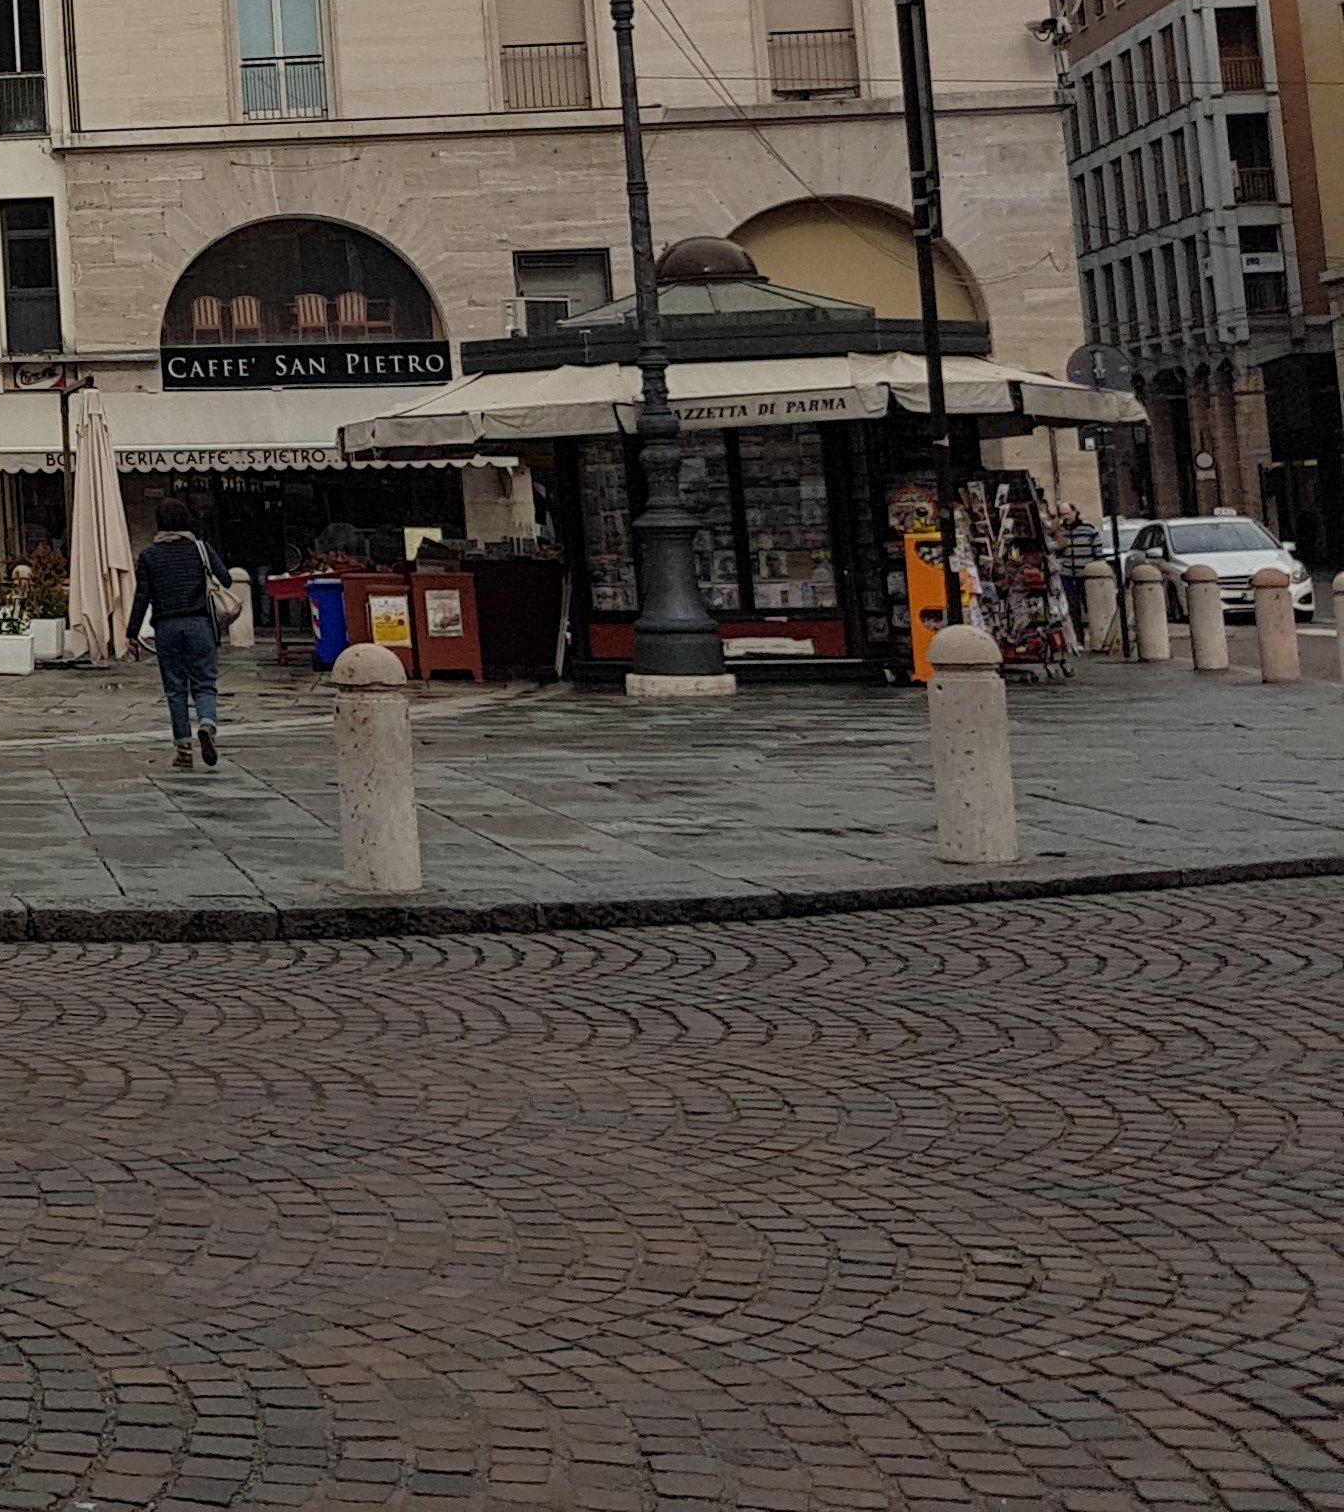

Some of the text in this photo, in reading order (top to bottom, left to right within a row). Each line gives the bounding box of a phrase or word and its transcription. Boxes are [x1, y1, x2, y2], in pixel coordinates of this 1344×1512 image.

[275, 355, 326, 376] SAN
[345, 353, 444, 375] PIETRO
[673, 397, 846, 421] AZZETTA DI PARMA
